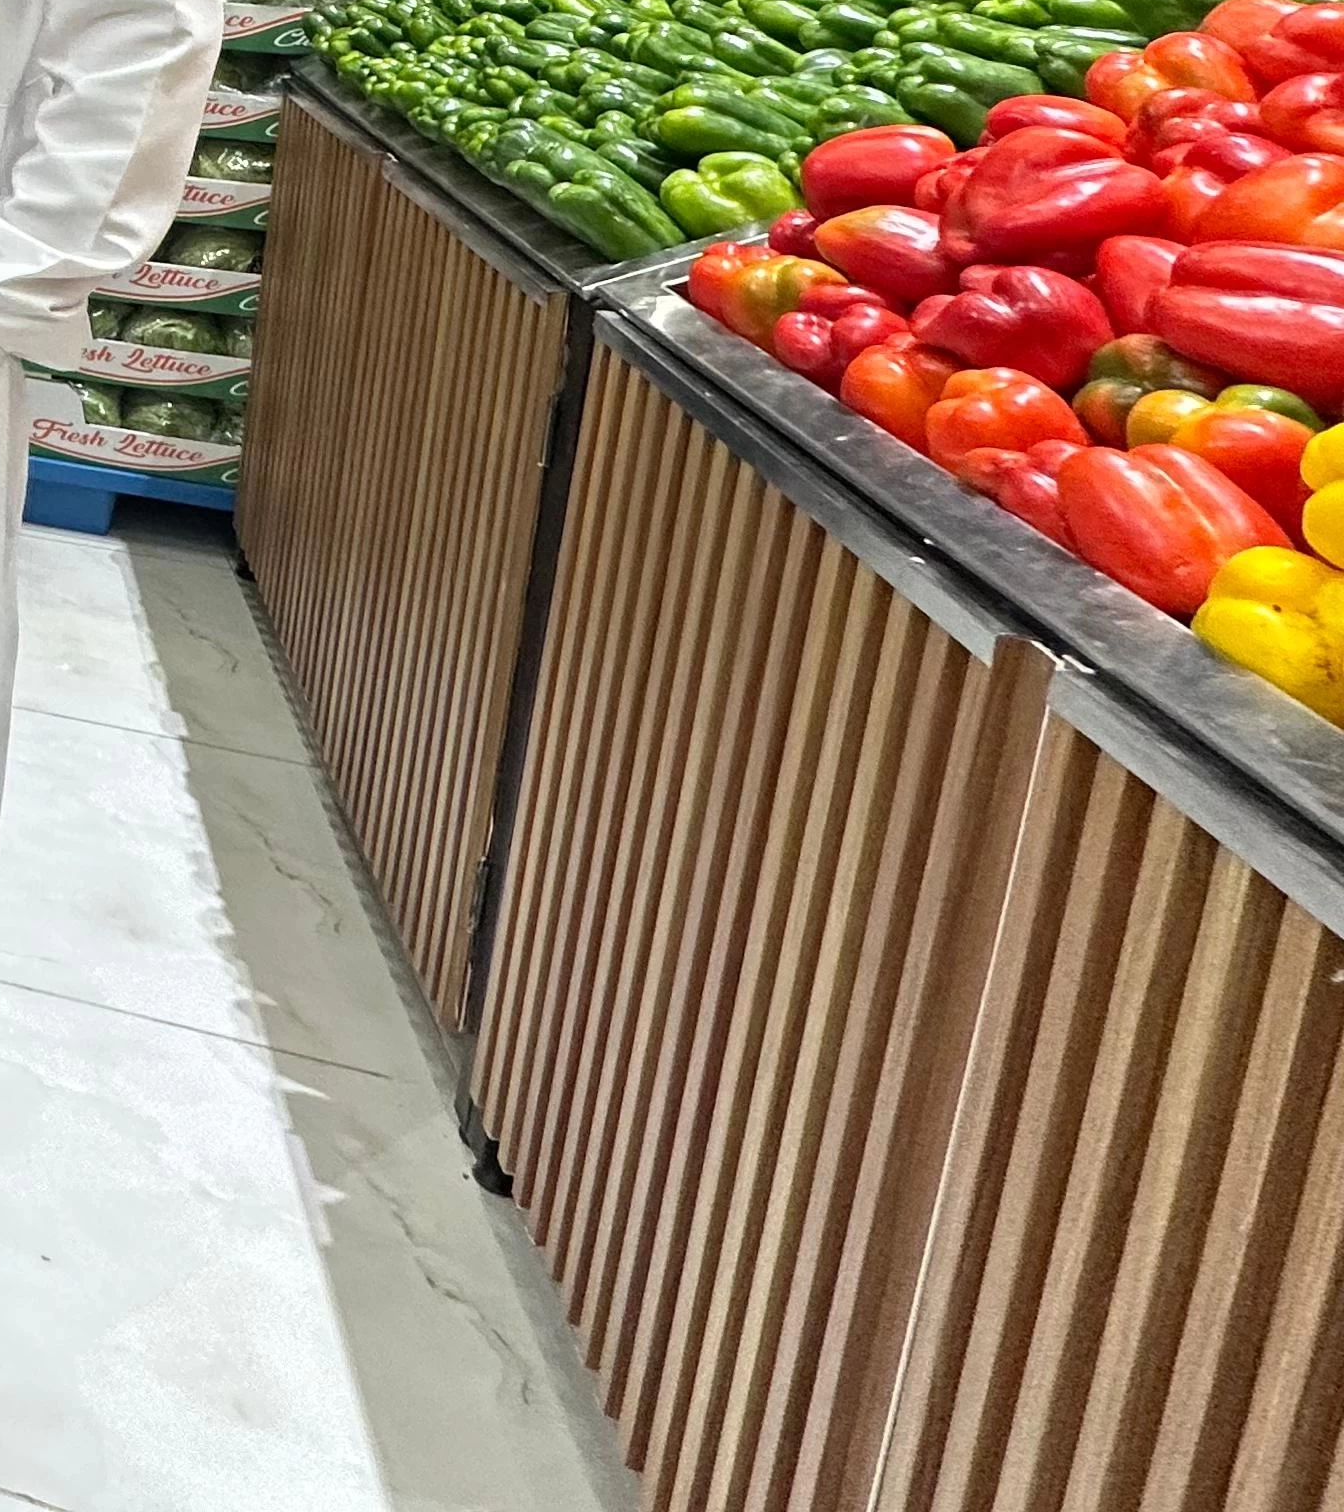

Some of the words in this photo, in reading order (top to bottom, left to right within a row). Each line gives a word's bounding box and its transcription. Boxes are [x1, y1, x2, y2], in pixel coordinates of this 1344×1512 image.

[182, 184, 236, 206] tuce
[129, 264, 221, 291] Lettuce
[121, 348, 213, 376] Lettuce
[33, 418, 108, 448] Fresh
[114, 434, 205, 463] Lettuce
